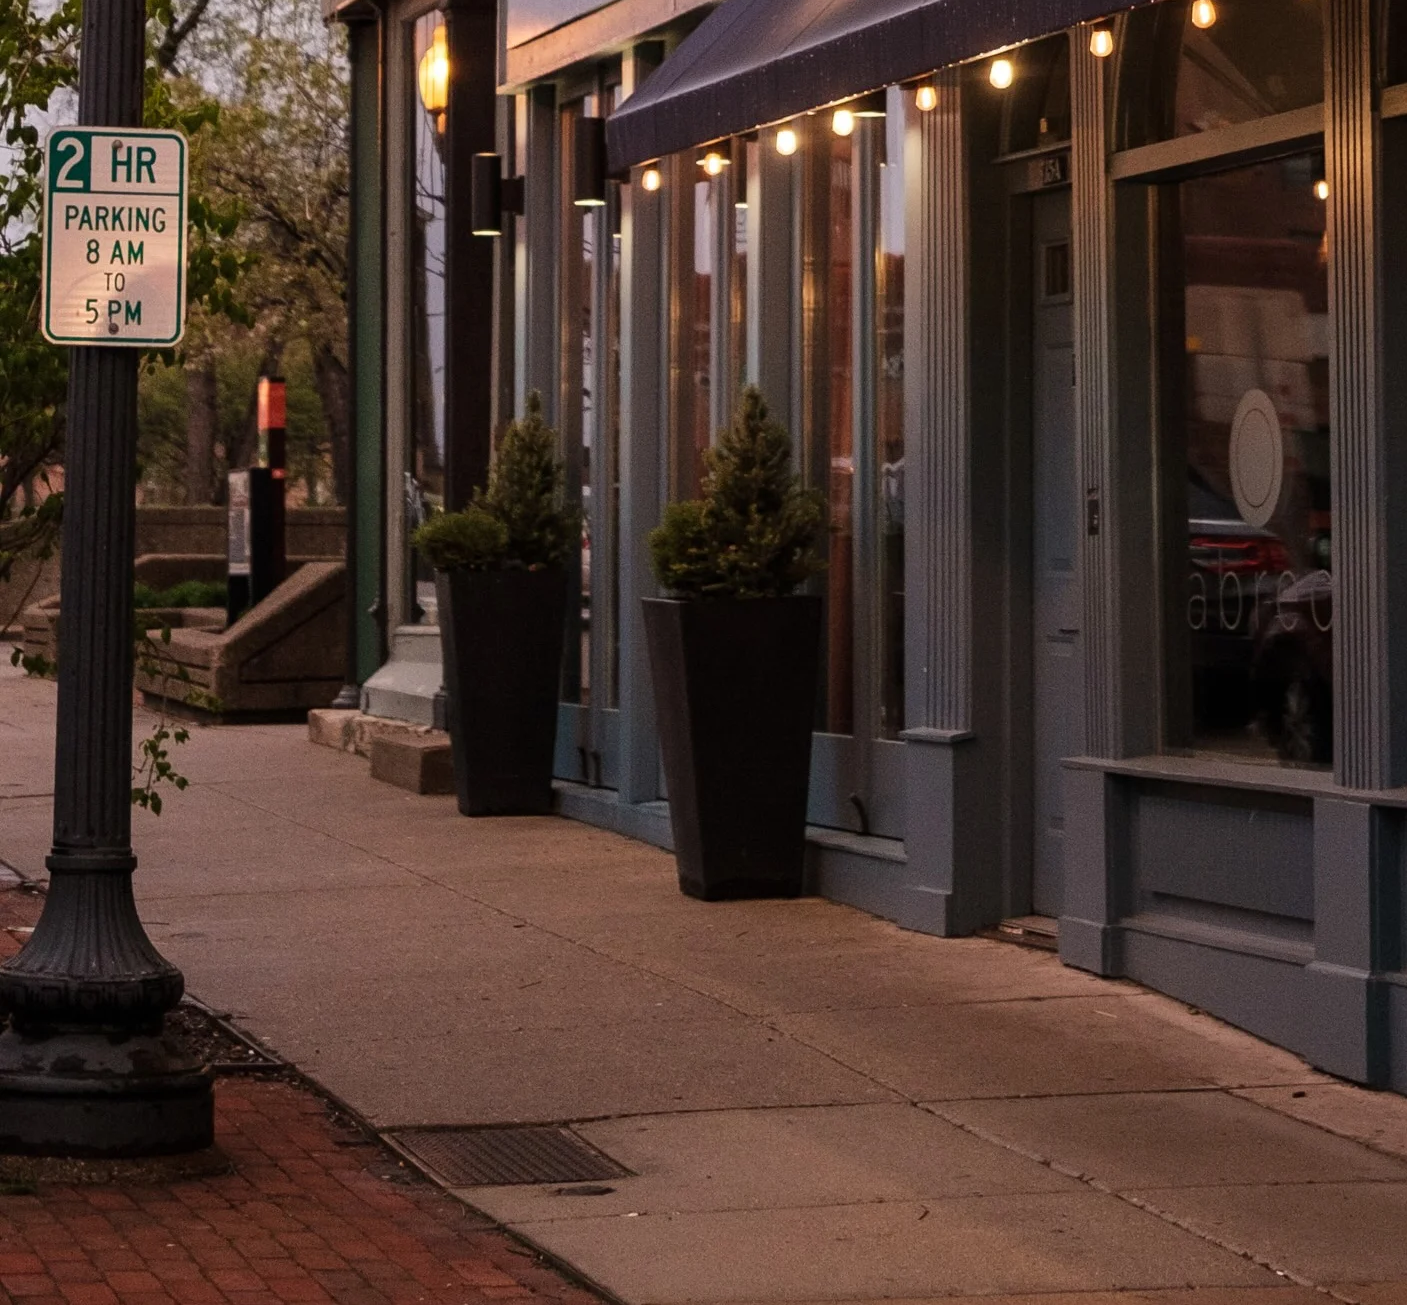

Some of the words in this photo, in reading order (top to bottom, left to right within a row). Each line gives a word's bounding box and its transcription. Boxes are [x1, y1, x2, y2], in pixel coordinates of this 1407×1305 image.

[56, 136, 85, 188] 2
[111, 146, 156, 184] HR
[65, 205, 166, 233] PARKING
[86, 239, 100, 265] 8
[110, 240, 144, 265] AM
[104, 272, 126, 292] TO
[86, 298, 99, 324] 5
[108, 300, 142, 326] PM
